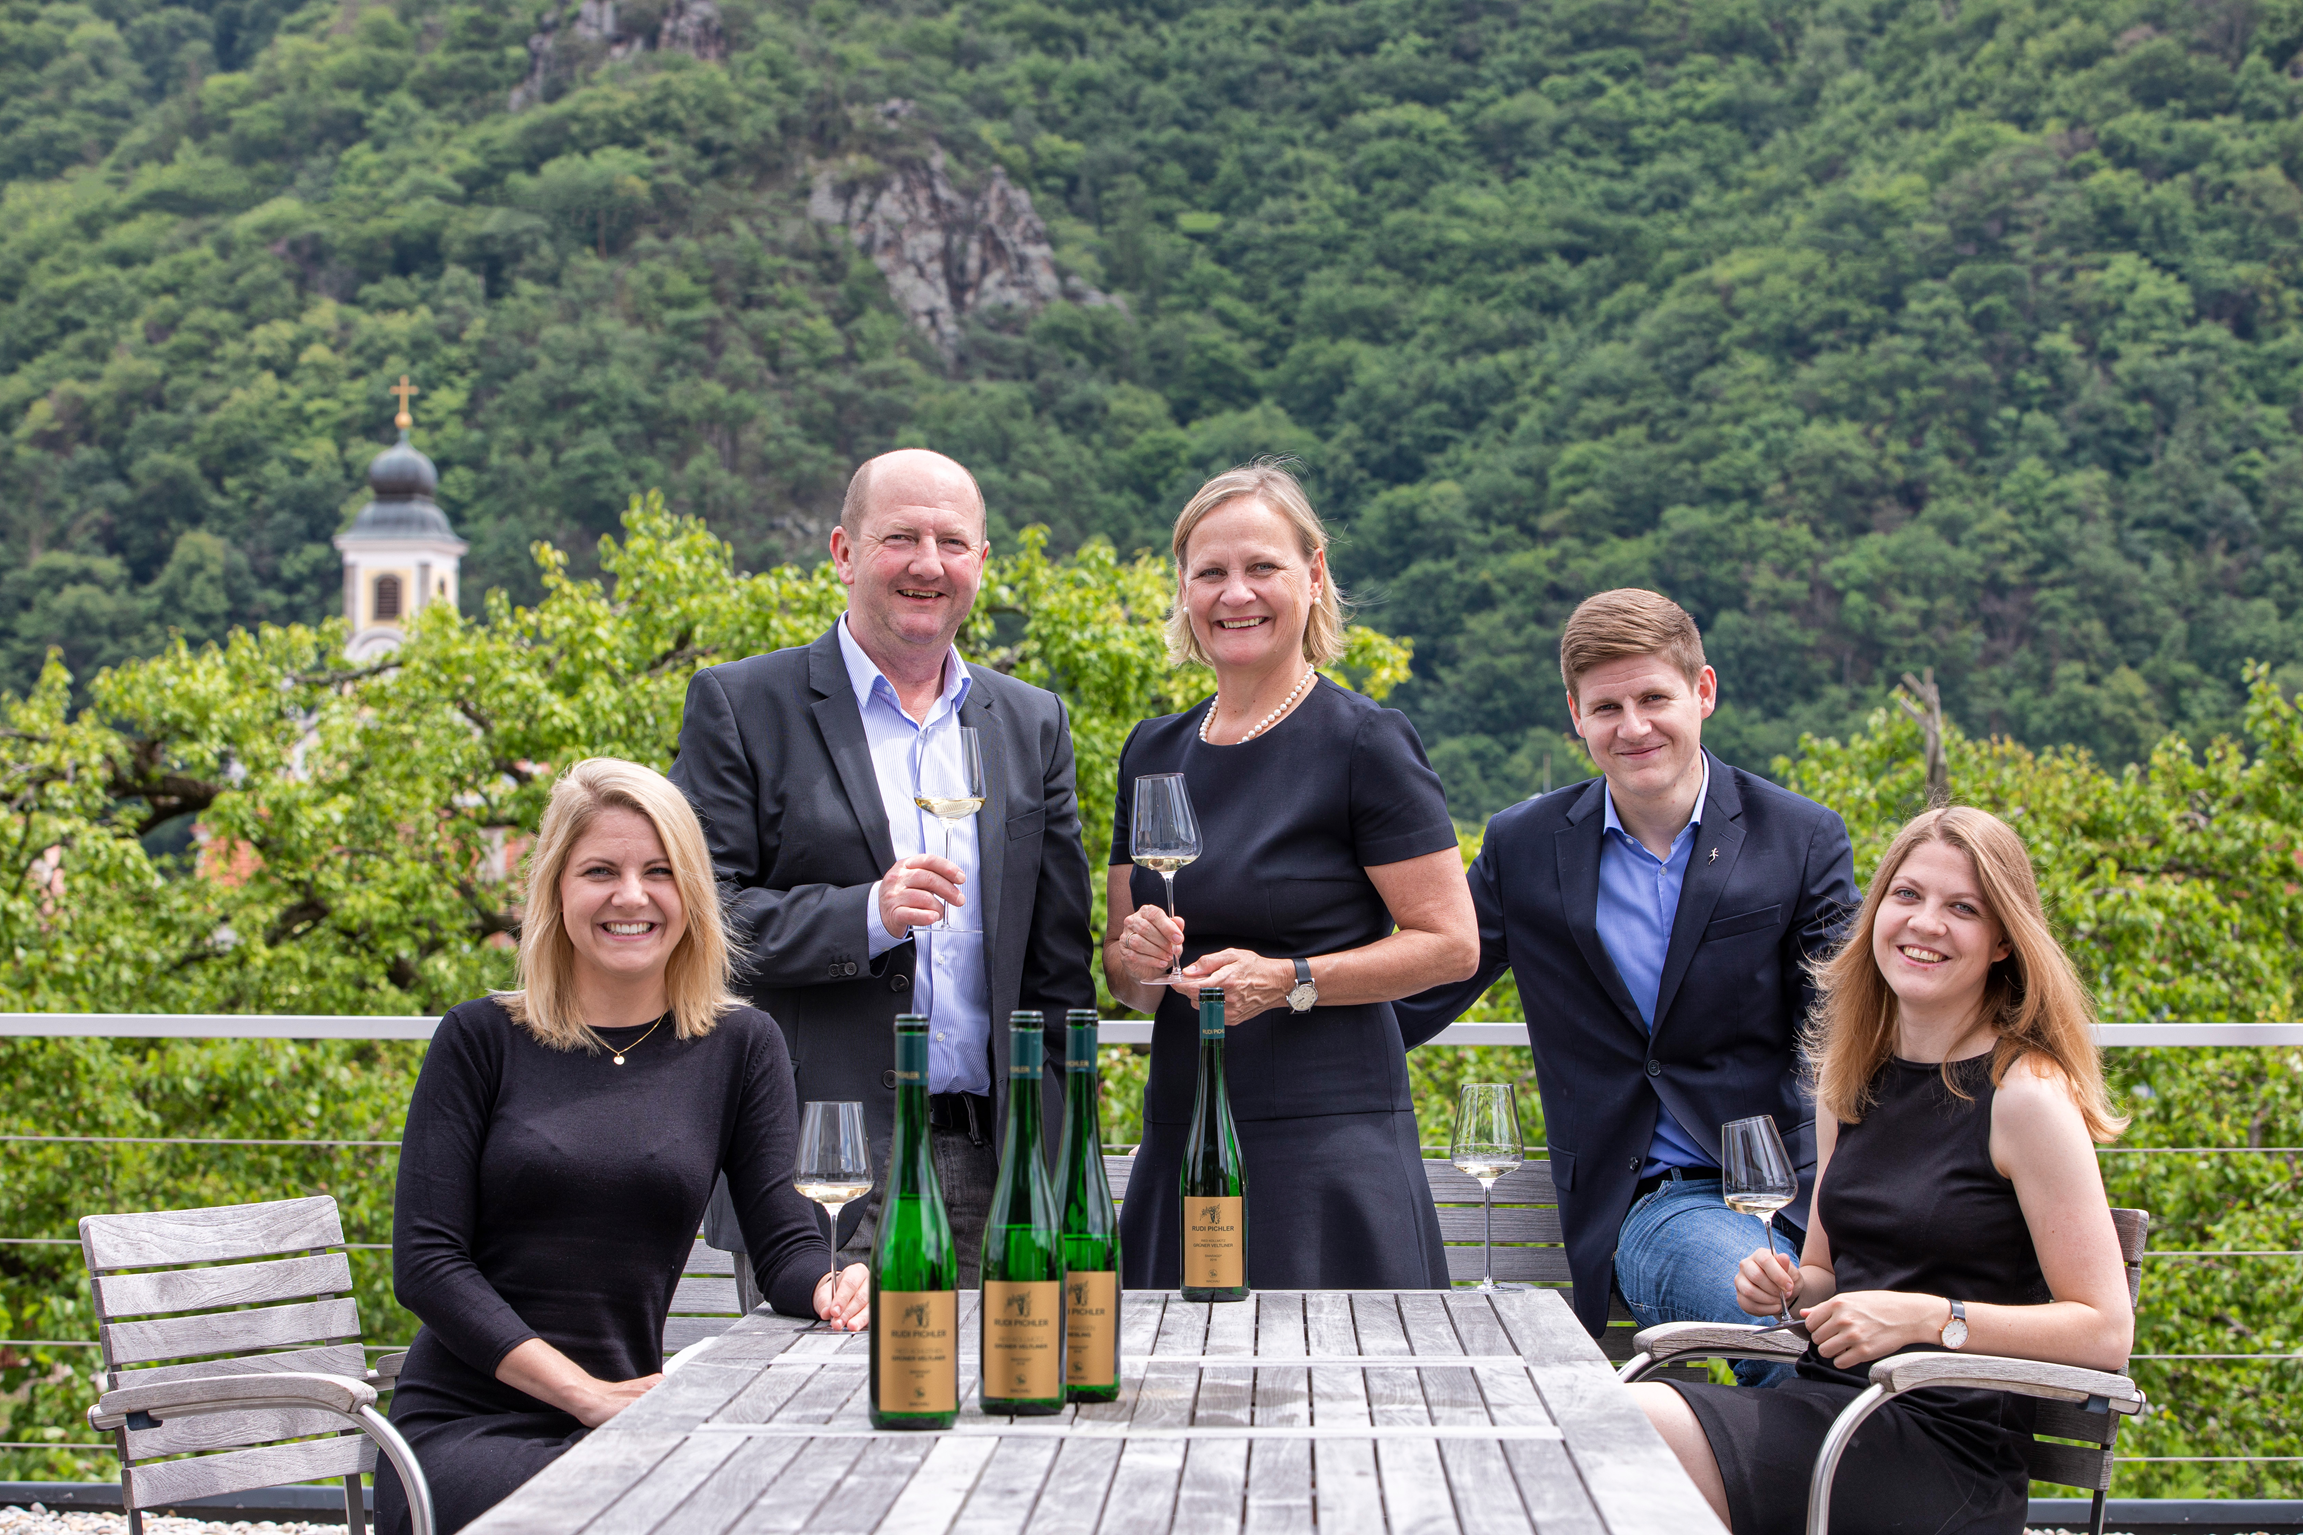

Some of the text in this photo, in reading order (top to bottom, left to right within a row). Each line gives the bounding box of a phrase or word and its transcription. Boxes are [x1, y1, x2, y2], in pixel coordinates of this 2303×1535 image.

[1071, 1307, 1106, 1316] PICHLER
[994, 1318, 1049, 1327] RUDI PICHLER
[890, 1329, 947, 1339] RUDI PICHLER
